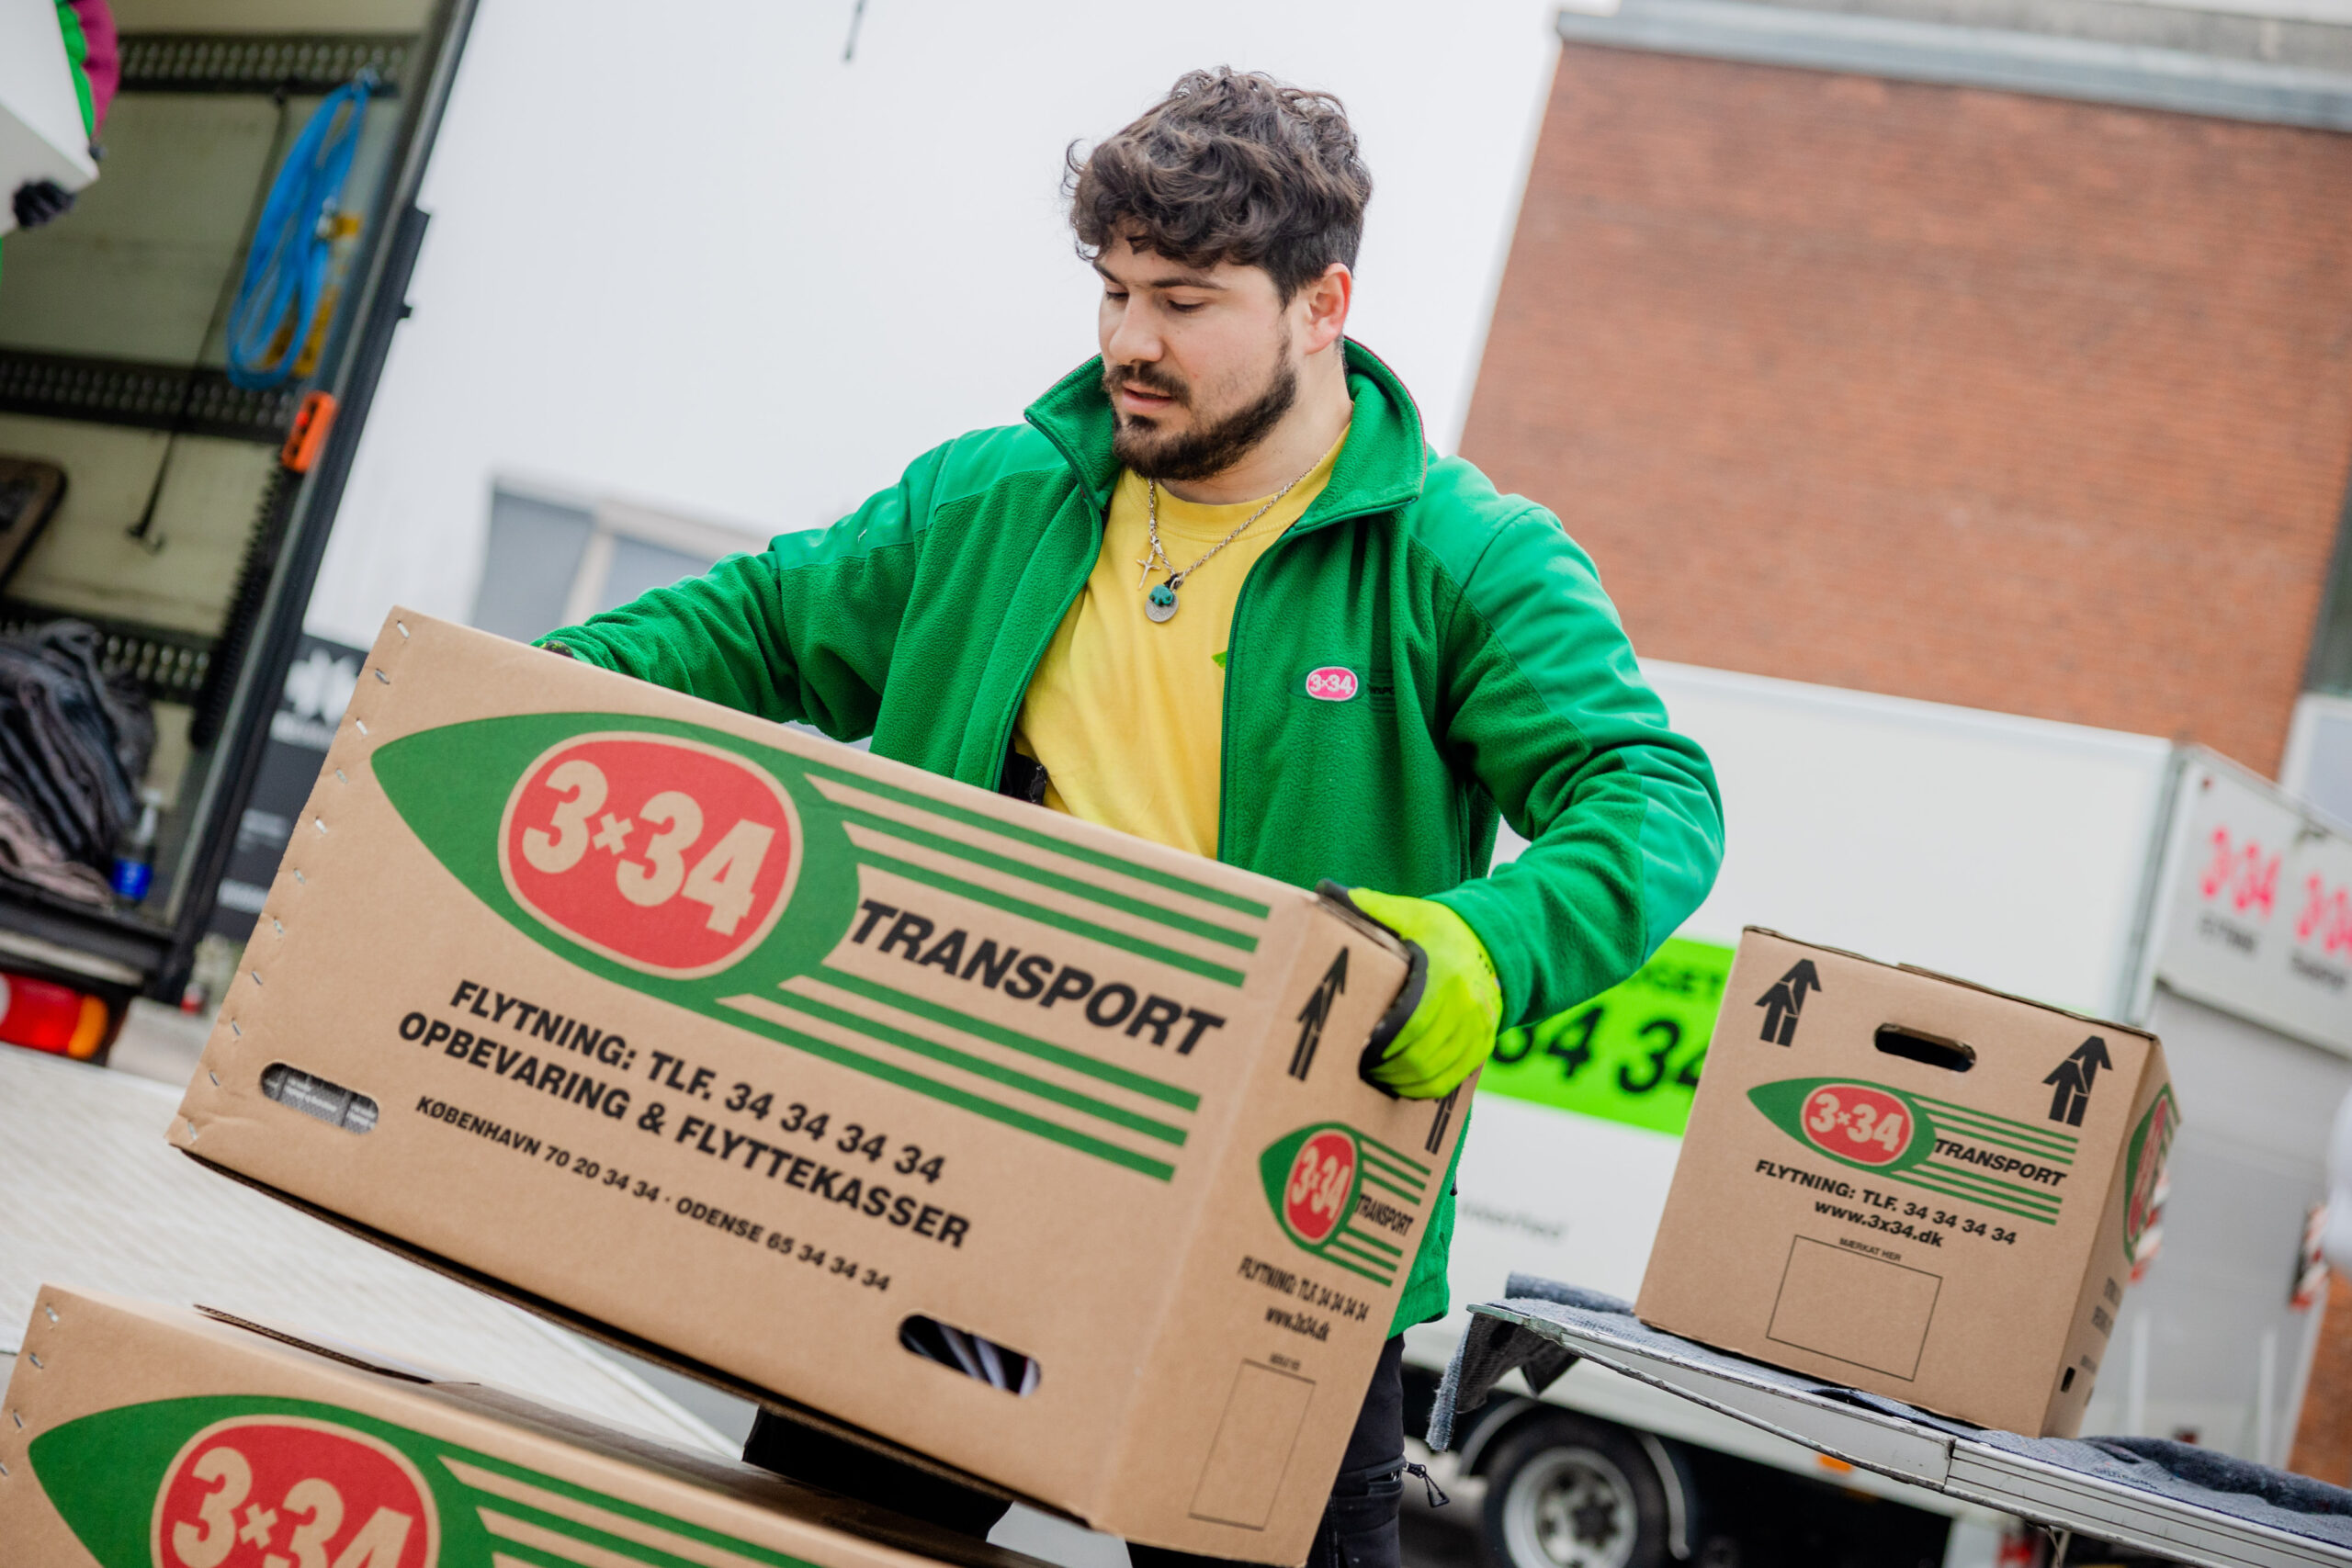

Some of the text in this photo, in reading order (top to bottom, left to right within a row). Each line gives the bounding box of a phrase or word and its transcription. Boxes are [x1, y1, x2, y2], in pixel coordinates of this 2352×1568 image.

[852, 898, 1227, 1056] TRANSPORT
[449, 979, 945, 1184] FLYTNING: TLF. 34 34 34 34
[1619, 1020, 1703, 1093] 3
[398, 1011, 971, 1249] OPBEVARING & FLYTTEKASSER
[1934, 1138, 2068, 1187] TRANSPORT
[415, 1095, 541, 1156] KØBENHAVN
[544, 1145, 571, 1168] 70
[572, 1156, 601, 1179] 20
[603, 1168, 630, 1190] 34
[632, 1180, 661, 1202] 34
[675, 1197, 765, 1243] ODENSE
[766, 1232, 795, 1256] 65
[797, 1243, 827, 1267] 34
[830, 1256, 858, 1280] 34
[862, 1268, 892, 1292] 34
[1356, 1193, 1414, 1236] TRANSPORT
[1755, 1159, 2018, 1247] FLYTNING: TLF. 34 34 34 34
[1815, 1201, 1944, 1248] www.3x34.dk
